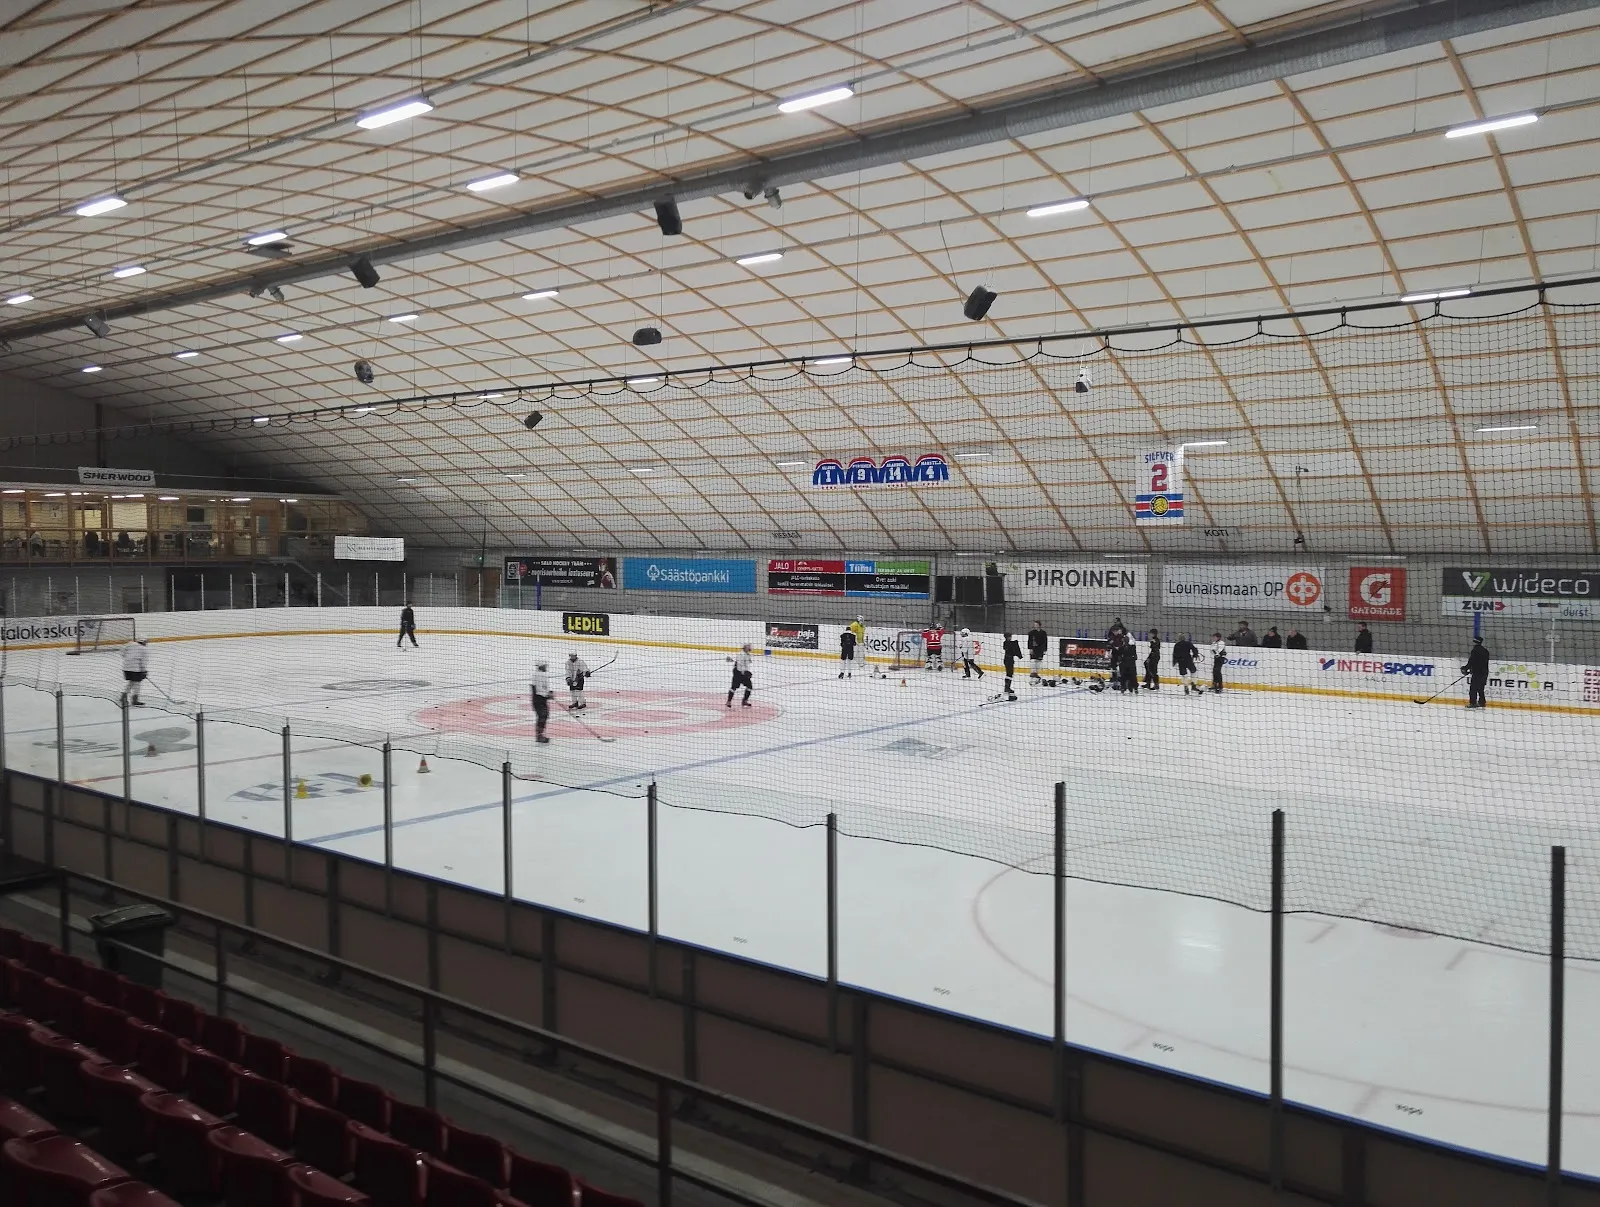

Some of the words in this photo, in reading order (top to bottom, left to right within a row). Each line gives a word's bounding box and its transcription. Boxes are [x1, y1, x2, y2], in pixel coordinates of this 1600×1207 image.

[83, 472, 151, 482] SHER-WOOD
[825, 470, 832, 483] 1
[857, 469, 866, 481] 9
[889, 467, 901, 480] 14
[926, 466, 934, 479] 4
[1152, 464, 1167, 491] 2
[1204, 529, 1229, 537] KOTI
[773, 561, 790, 570] JALO
[660, 568, 730, 583] Säästöpankki
[1024, 569, 1136, 588] PIIROINEN
[1168, 580, 1258, 596] Lounaismaan
[1263, 581, 1284, 597] OP
[1493, 573, 1590, 595] wideco
[1351, 607, 1402, 616] GATORADE
[1563, 606, 1589, 617] durst
[1337, 660, 1434, 677] INTERSPORT
